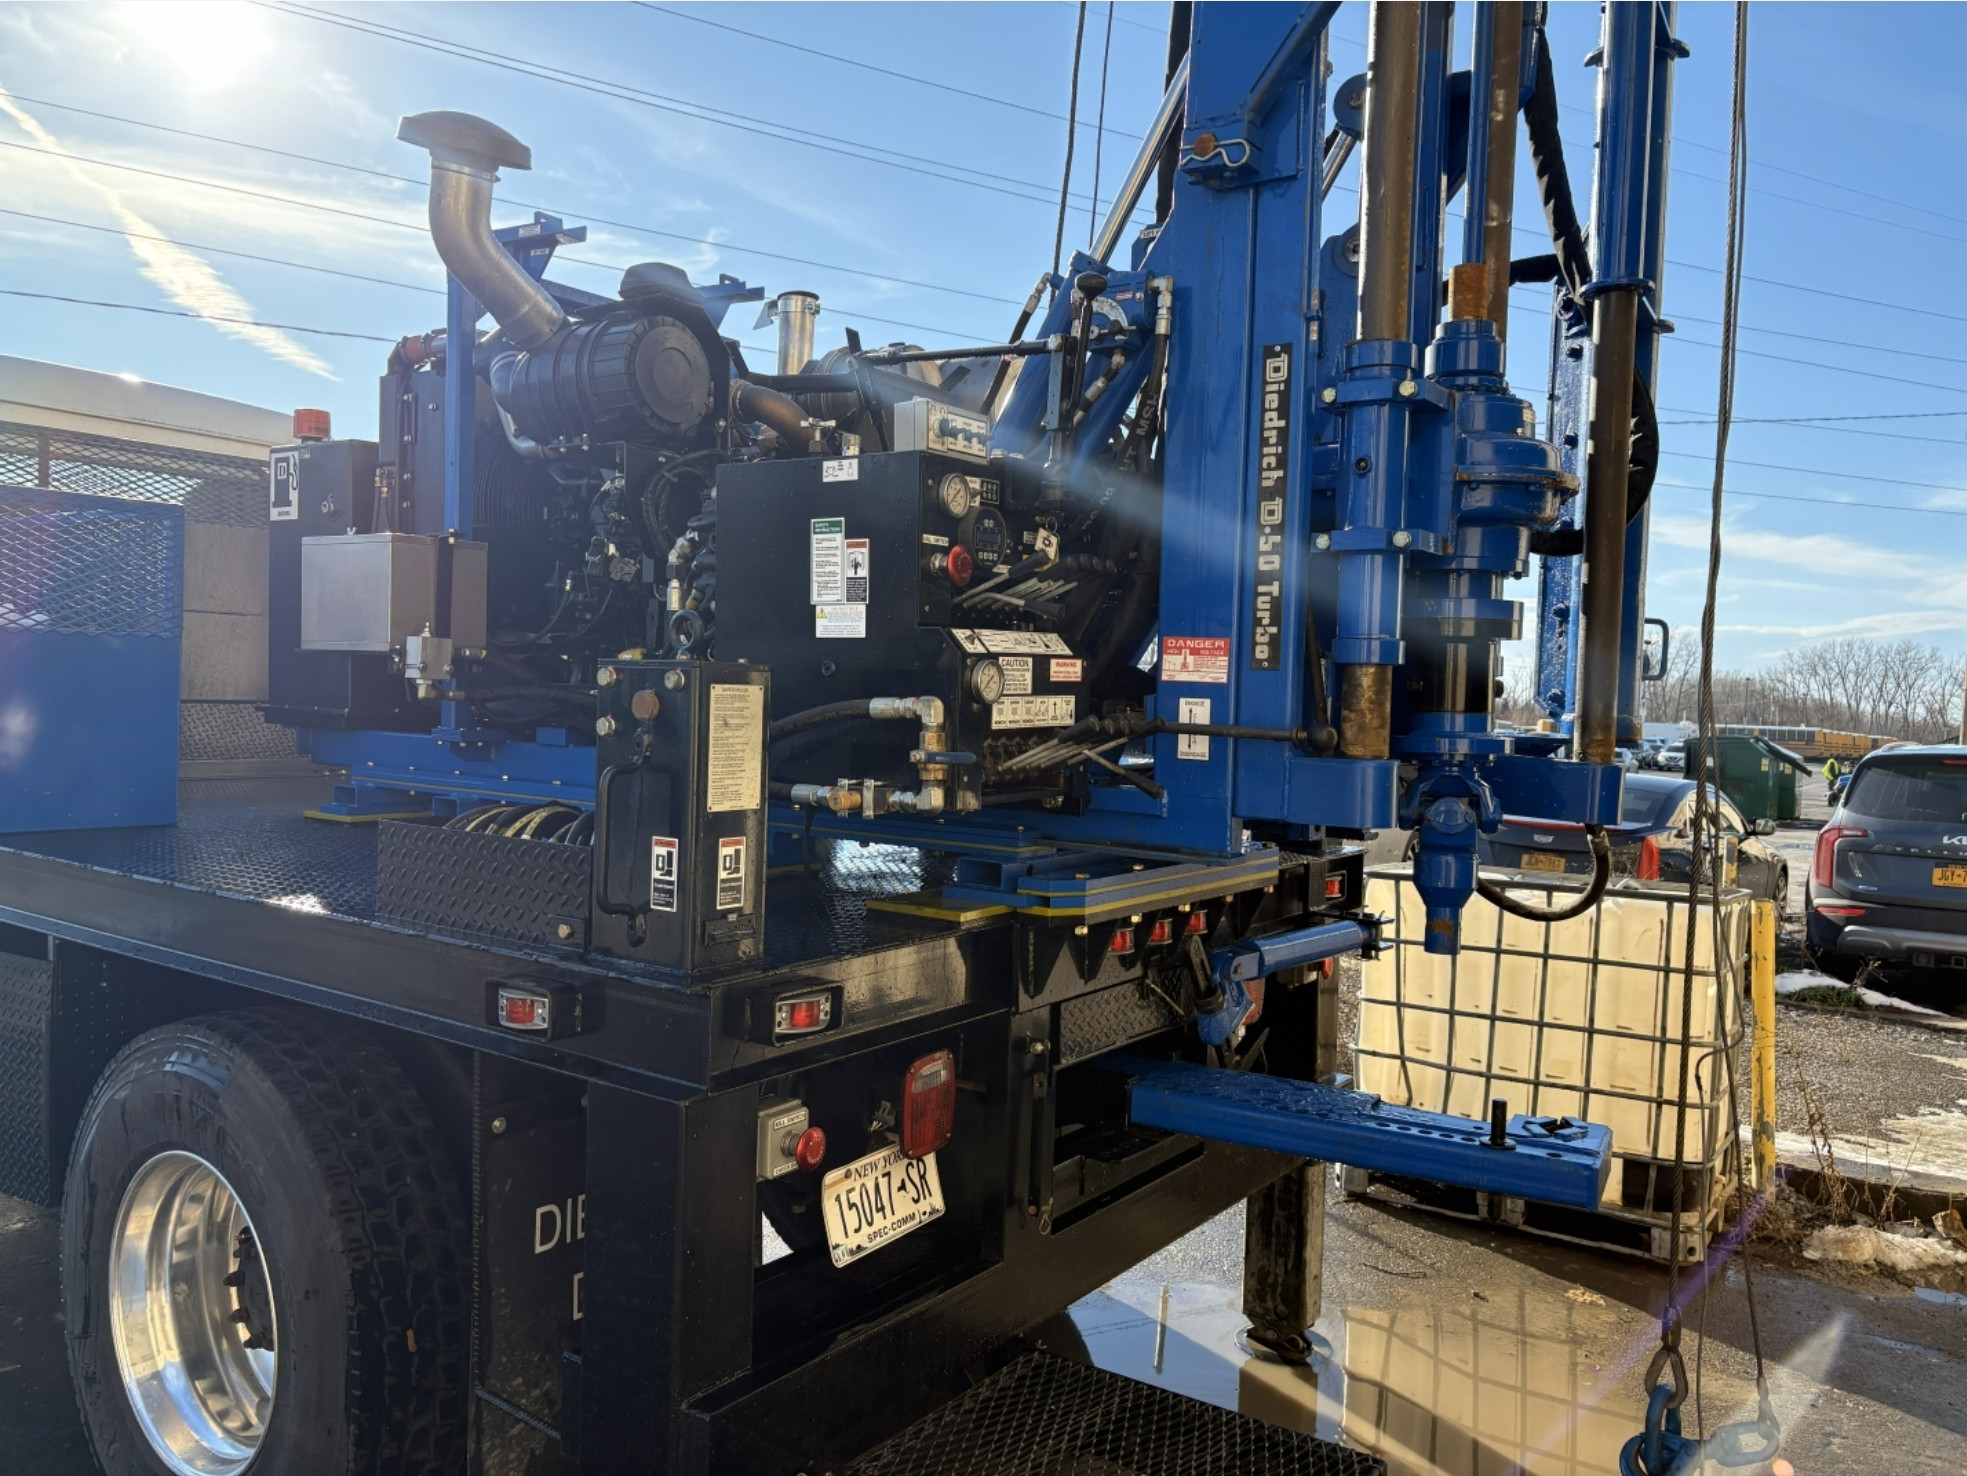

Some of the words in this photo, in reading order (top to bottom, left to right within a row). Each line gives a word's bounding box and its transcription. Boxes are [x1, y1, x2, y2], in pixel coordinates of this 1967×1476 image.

[1261, 352, 1288, 487] Diedrich
[1255, 580, 1280, 660] Turbo
[1167, 639, 1225, 649] DANGER
[1001, 659, 1029, 668] CAUTION
[854, 1159, 881, 1181] NEW
[867, 1211, 916, 1243] SPEC-COMM
